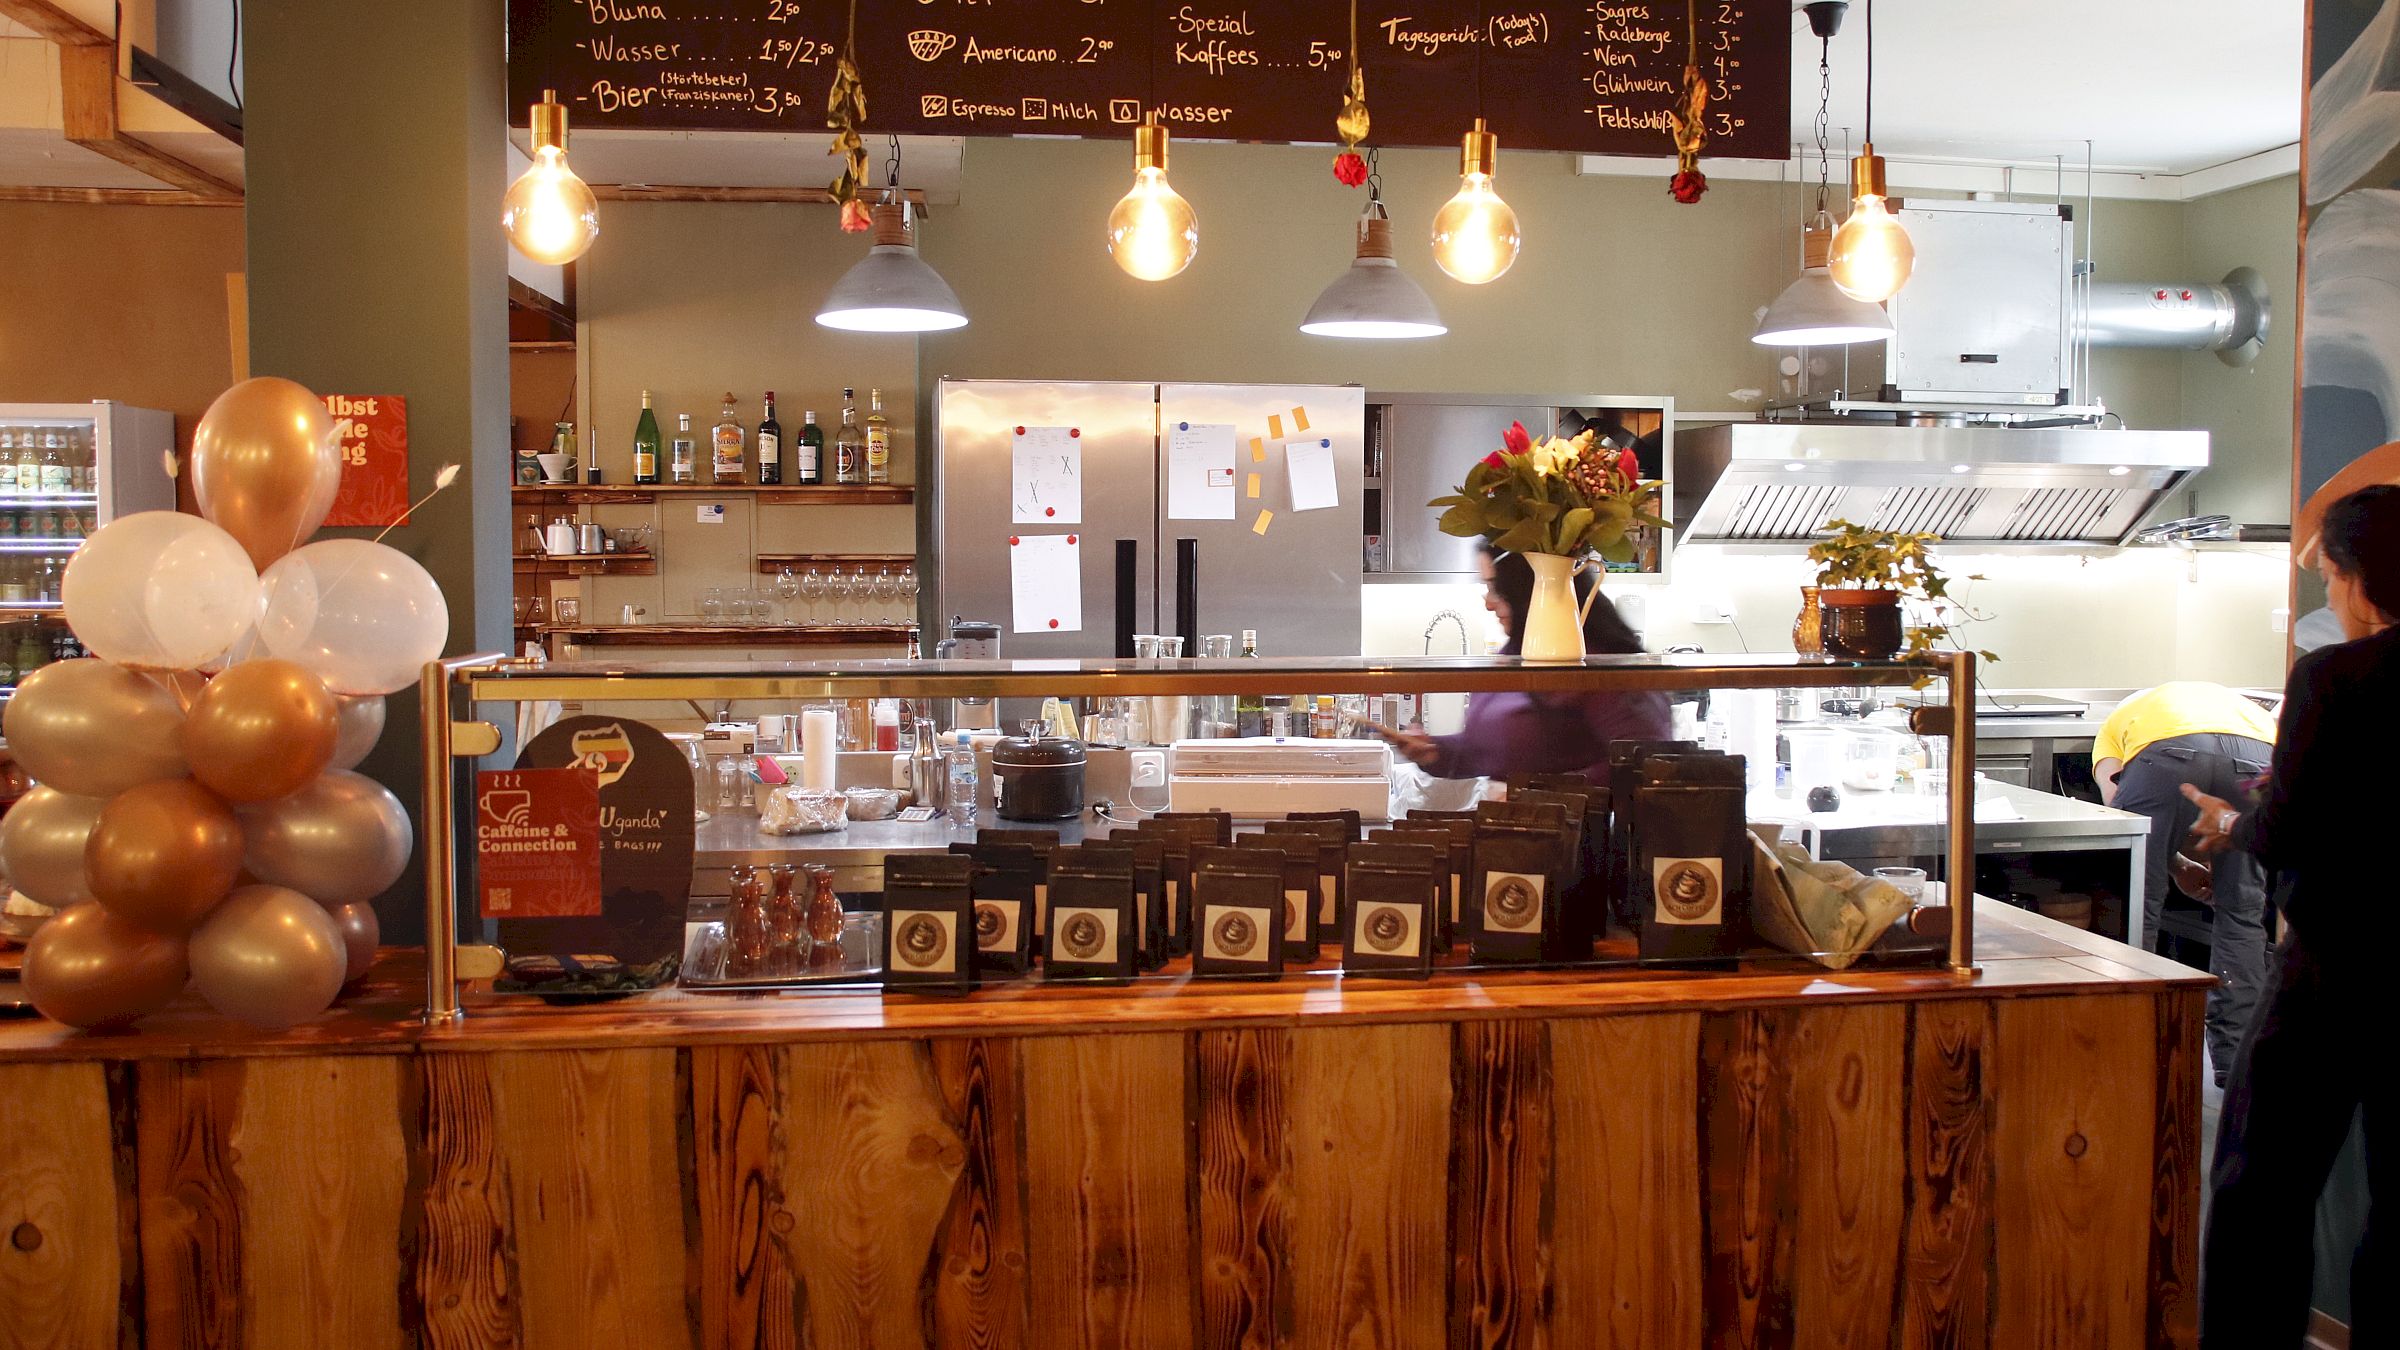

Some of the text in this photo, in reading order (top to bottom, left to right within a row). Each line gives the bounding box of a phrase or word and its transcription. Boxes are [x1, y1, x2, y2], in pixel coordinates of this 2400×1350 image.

[591, 0, 667, 24] Bluna
[1179, 6, 1255, 39] Spezial
[1597, 0, 1650, 28] Sagres
[592, 35, 681, 62] Wasser
[964, 36, 1057, 64] Americano
[1176, 41, 1259, 75] Kaffees
[1594, 45, 1637, 67] Wein
[1593, 70, 1675, 96] Glühwein
[592, 80, 657, 113] Bier
[953, 98, 1016, 120] Espresso
[1053, 102, 1098, 121] Milch
[324, 395, 378, 416] lbst
[478, 823, 569, 839] Caffeine &
[478, 838, 577, 853] Connection
